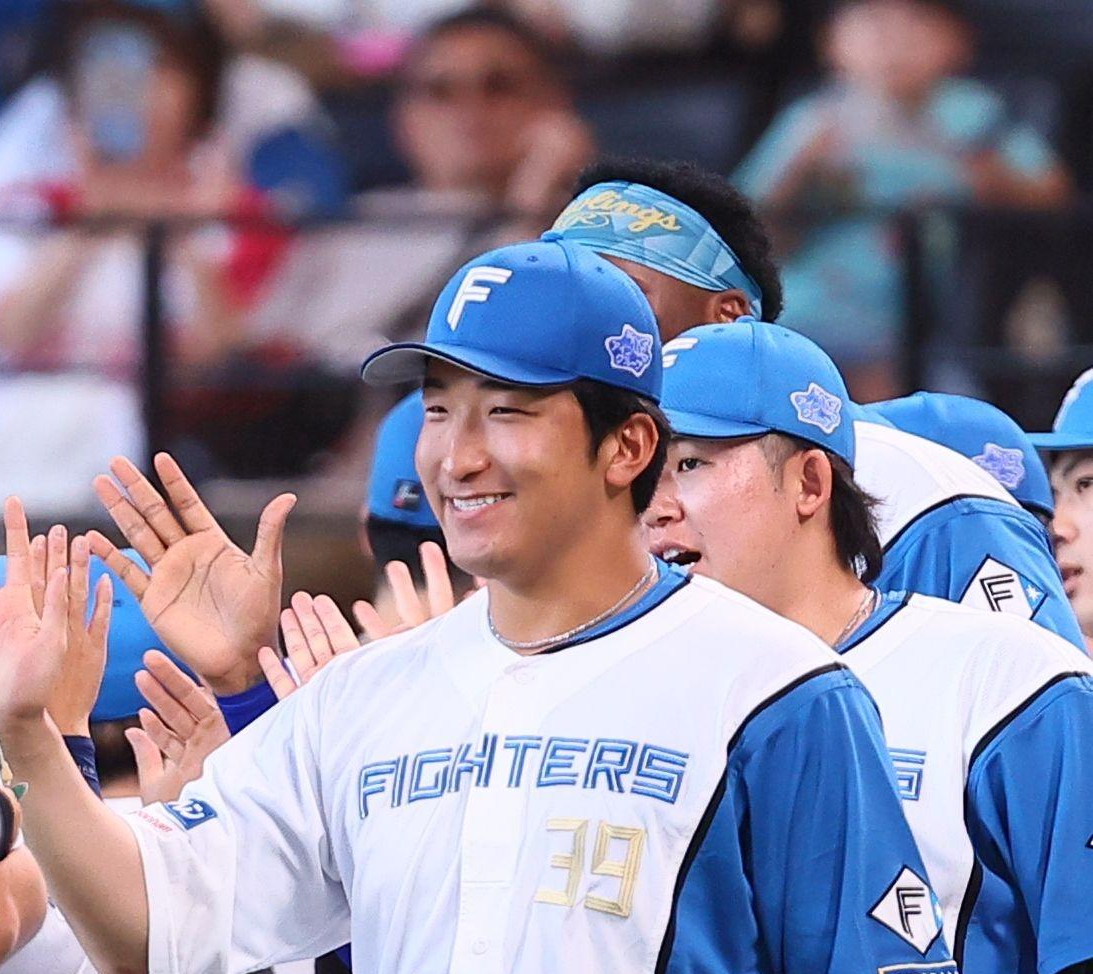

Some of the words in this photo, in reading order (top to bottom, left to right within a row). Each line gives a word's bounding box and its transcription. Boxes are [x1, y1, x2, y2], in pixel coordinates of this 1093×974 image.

[447, 265, 514, 332] F
[358, 733, 690, 820] FIGHTERS
[534, 817, 647, 918] 39
[895, 886, 926, 939] F
